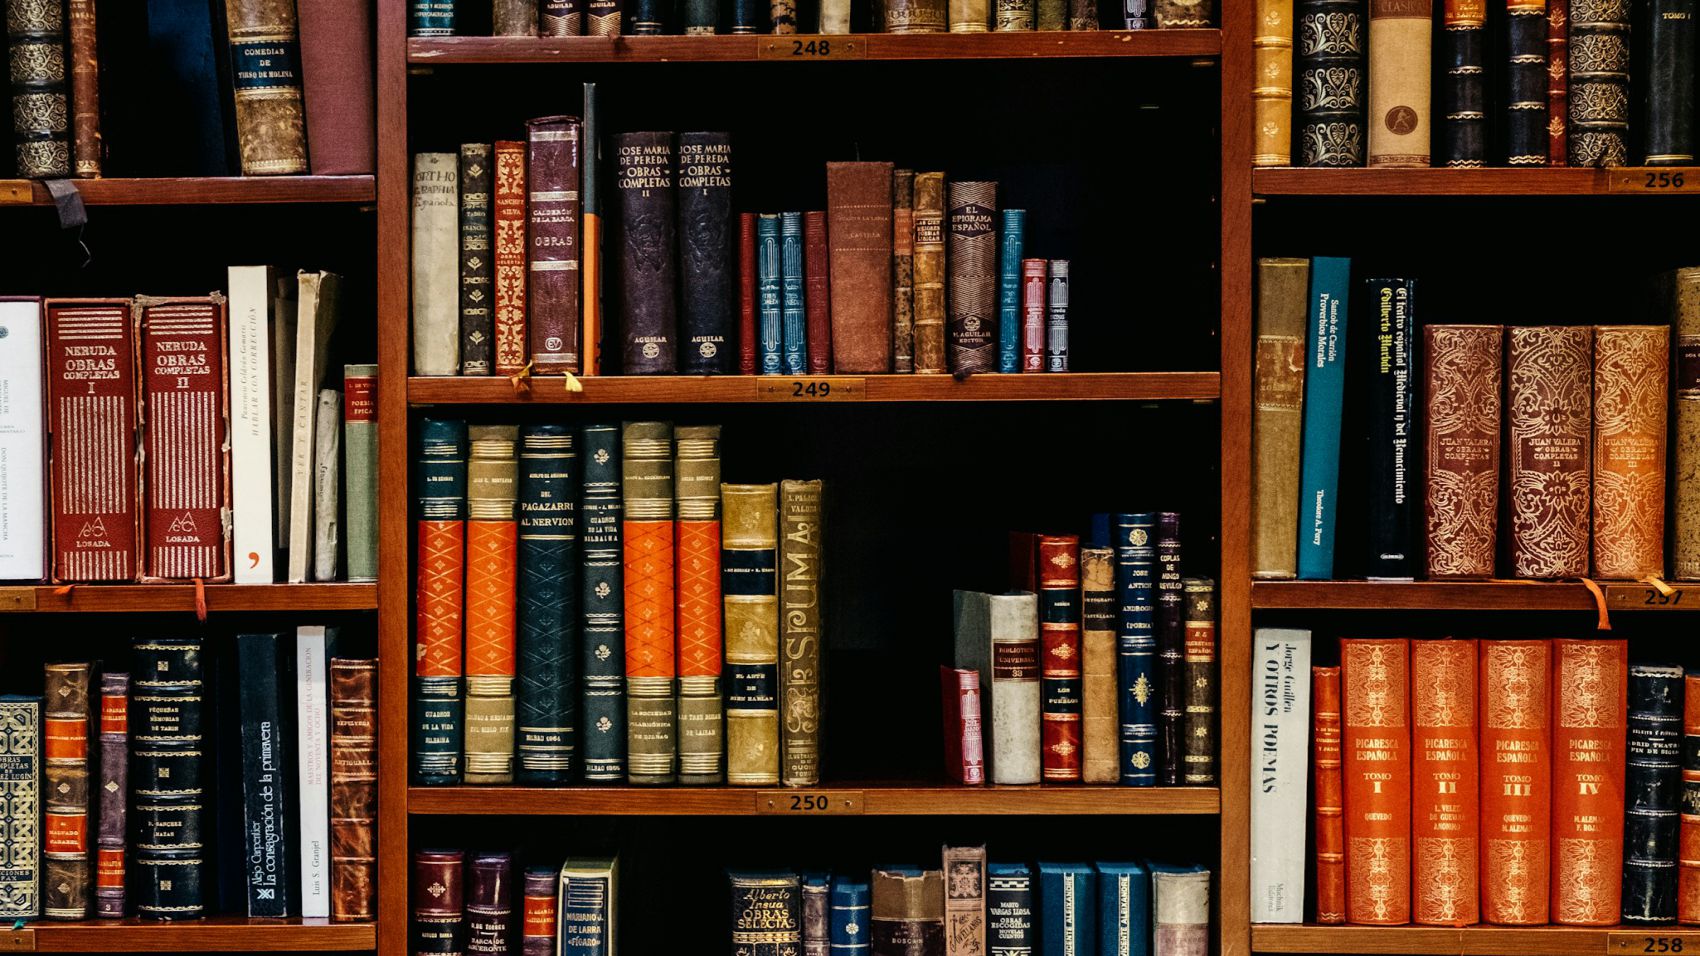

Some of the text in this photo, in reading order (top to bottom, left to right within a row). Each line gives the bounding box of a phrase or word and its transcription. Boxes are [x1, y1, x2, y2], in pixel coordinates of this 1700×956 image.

[1663, 12, 1686, 20] TOMO
[244, 48, 284, 56] COMEDIAS
[792, 40, 830, 56] 248
[619, 145, 670, 155] JOSE MARIA
[679, 145, 731, 154] JOSE MARIA
[620, 156, 668, 165] DE PEREDA
[681, 155, 729, 164] DE PEREDA
[626, 166, 661, 177] OBRAS
[688, 165, 722, 176] OBRAS
[619, 178, 670, 188] COMPLETAS
[680, 176, 731, 187] COMPLETAS
[1644, 172, 1685, 188] 256
[703, 188, 708, 196] I
[952, 222, 991, 231] ESPAÑOL
[535, 236, 573, 246] OBRAS
[1396, 301, 1406, 329] teatro
[1317, 293, 1330, 368] Proverbios Morales
[1328, 300, 1339, 362] Santob de Carrión
[248, 306, 258, 371] CORRECCIÓN
[65, 346, 117, 356] NERUDA
[156, 341, 208, 352] NERUDA
[1394, 331, 1406, 366] español
[66, 358, 116, 371] OBRAS
[157, 354, 207, 366] OBRAS
[64, 370, 120, 380] COMPLETAS
[154, 366, 210, 375] COMPLETAS
[87, 382, 96, 394] I
[250, 375, 258, 393] CON
[792, 382, 830, 397] 249
[1395, 423, 1406, 436] del
[1393, 438, 1406, 504] Renacimiento
[1316, 490, 1324, 519] Theodore
[521, 518, 574, 526] AL NERVION
[76, 540, 111, 548] LOSADA
[166, 535, 200, 543] LOSADA
[1646, 590, 1683, 605] 257
[1283, 643, 1297, 713] Jorge Guillén
[1262, 643, 1280, 794] Y OTROS POEMAS
[1356, 739, 1399, 748] PICARESCA
[1425, 738, 1467, 748] PICARESCA
[1496, 740, 1539, 750] PICARESCA
[1570, 740, 1612, 749] PICARESCA
[1357, 750, 1397, 760] ESPAÑOLA
[1426, 750, 1466, 760] ESPAÑOLA
[1497, 752, 1537, 762] ESPAÑOLA
[1570, 751, 1610, 762] ESPAÑOLA
[1374, 782, 1382, 794] I
[1439, 782, 1456, 794] II
[1504, 784, 1532, 796] III
[1579, 782, 1601, 794] IV
[259, 721, 280, 886] La consagración de la primavera
[790, 795, 828, 810] 250
[1365, 813, 1392, 821] QUEVEDO
[250, 821, 265, 885] Alejo Carpentier
[311, 840, 321, 868] Granjel
[312, 879, 320, 895] Luis
[743, 888, 790, 900] Alberto
[749, 900, 784, 910] Insua
[743, 910, 789, 920] OBRAS
[738, 919, 796, 929] SELECTAS
[579, 926, 601, 934] LARRA
[1644, 937, 1683, 953] 258
